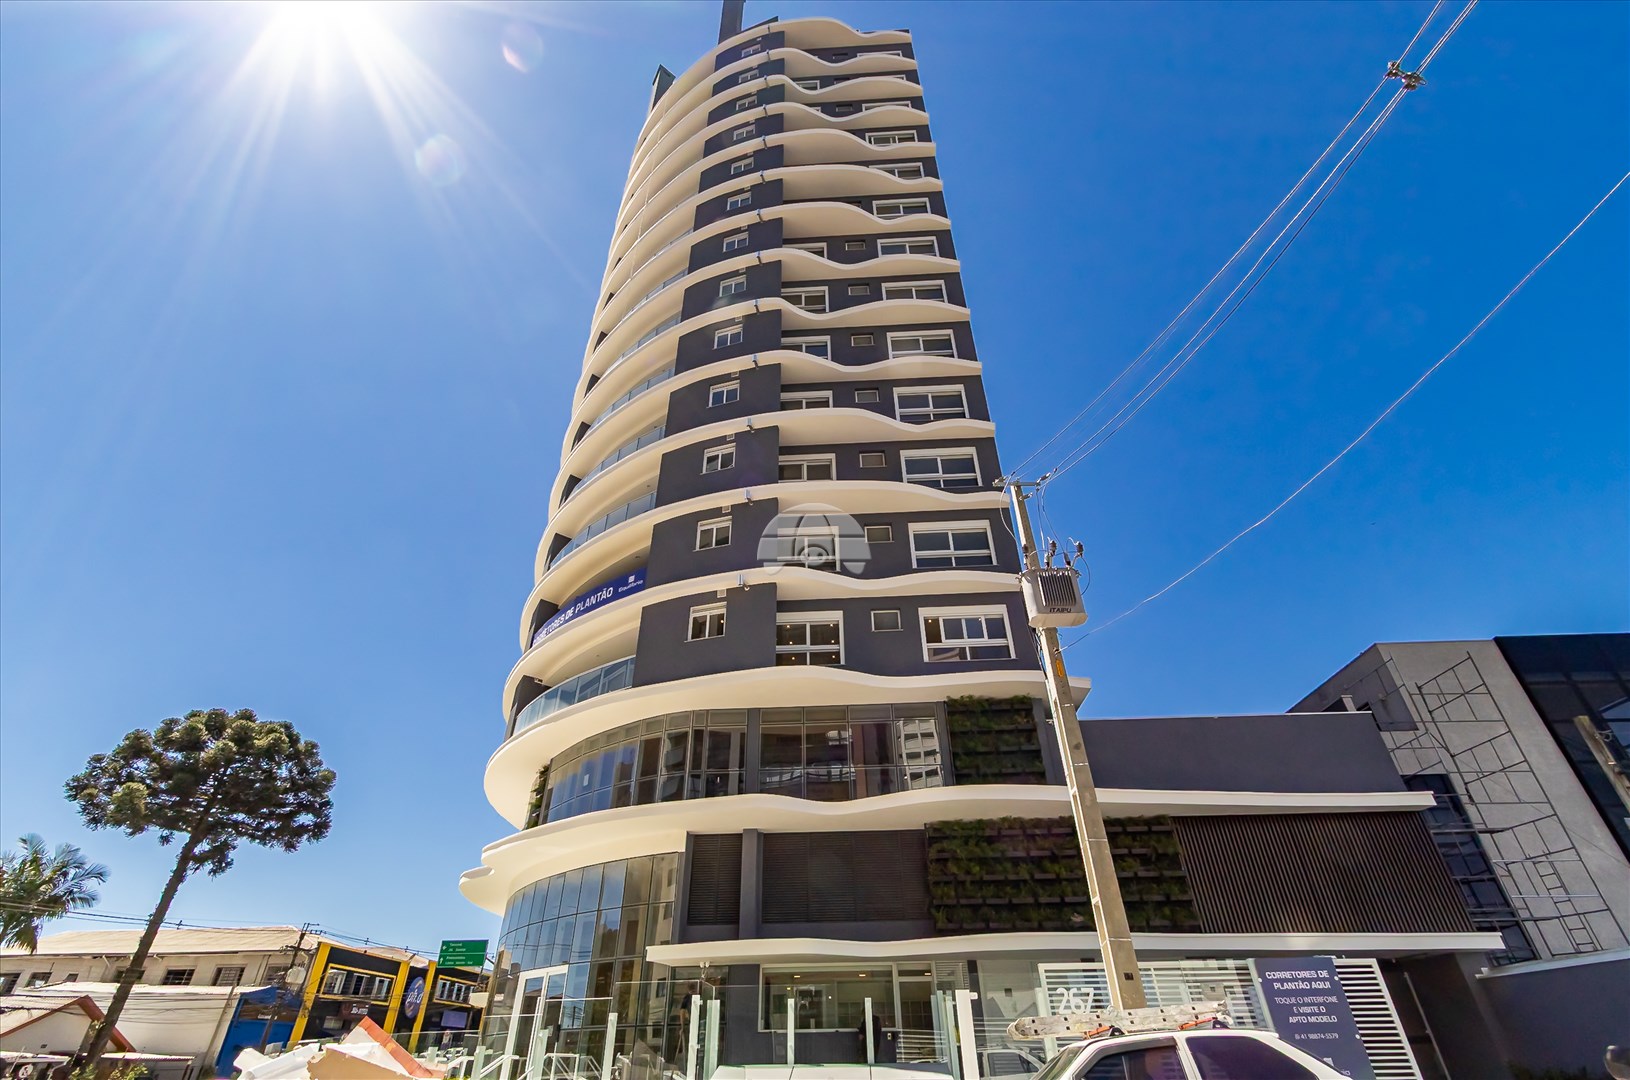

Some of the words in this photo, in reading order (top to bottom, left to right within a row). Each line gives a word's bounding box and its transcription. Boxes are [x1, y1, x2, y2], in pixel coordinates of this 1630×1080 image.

[575, 587, 613, 613] PLANTÃO
[1265, 970, 1317, 979] CORRETORES
[1317, 970, 1330, 978] DE
[1273, 980, 1310, 990] PLANTÃO
[1311, 981, 1331, 989] AQUI
[1055, 987, 1095, 1015] 267
[1274, 996, 1297, 1004] TOQUE
[1297, 996, 1303, 1004] O
[1303, 995, 1339, 1003] INTERFONE
[1320, 1005, 1326, 1013] O
[1307, 1015, 1338, 1023] MODELO
